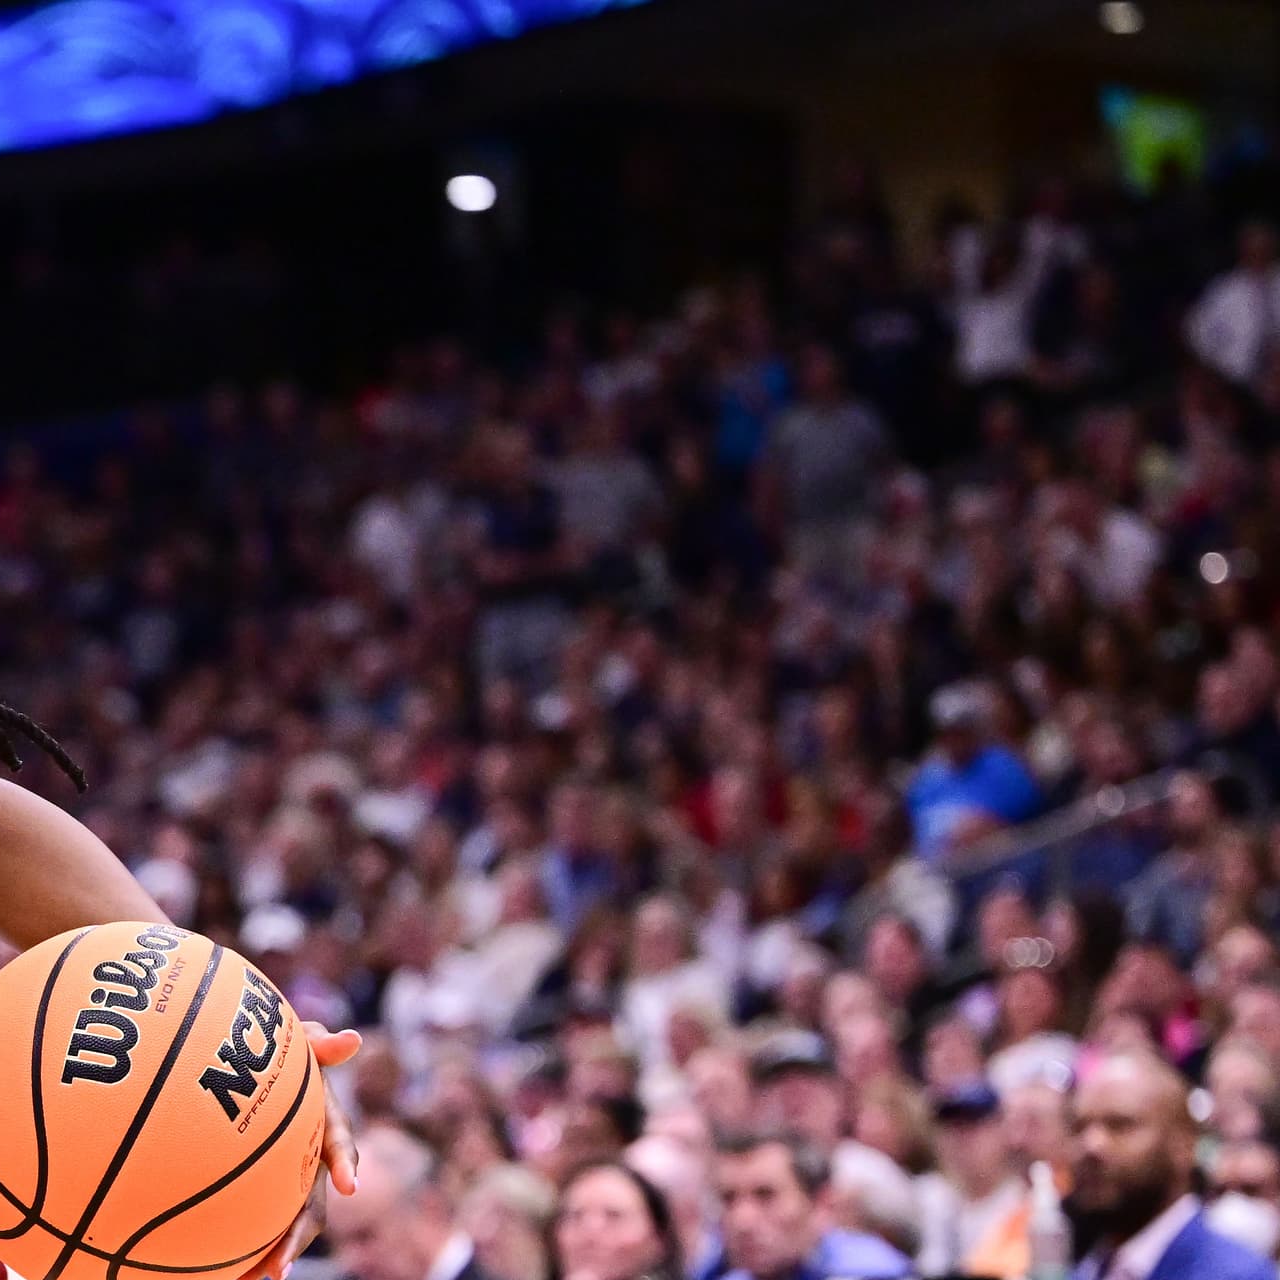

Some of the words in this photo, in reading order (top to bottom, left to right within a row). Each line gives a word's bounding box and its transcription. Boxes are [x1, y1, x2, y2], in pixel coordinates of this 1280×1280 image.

[155, 983, 174, 1014] EVO
[167, 957, 188, 982] NXT
[197, 967, 284, 1124] NCAA
[237, 1072, 280, 1134] OFFICIAL
